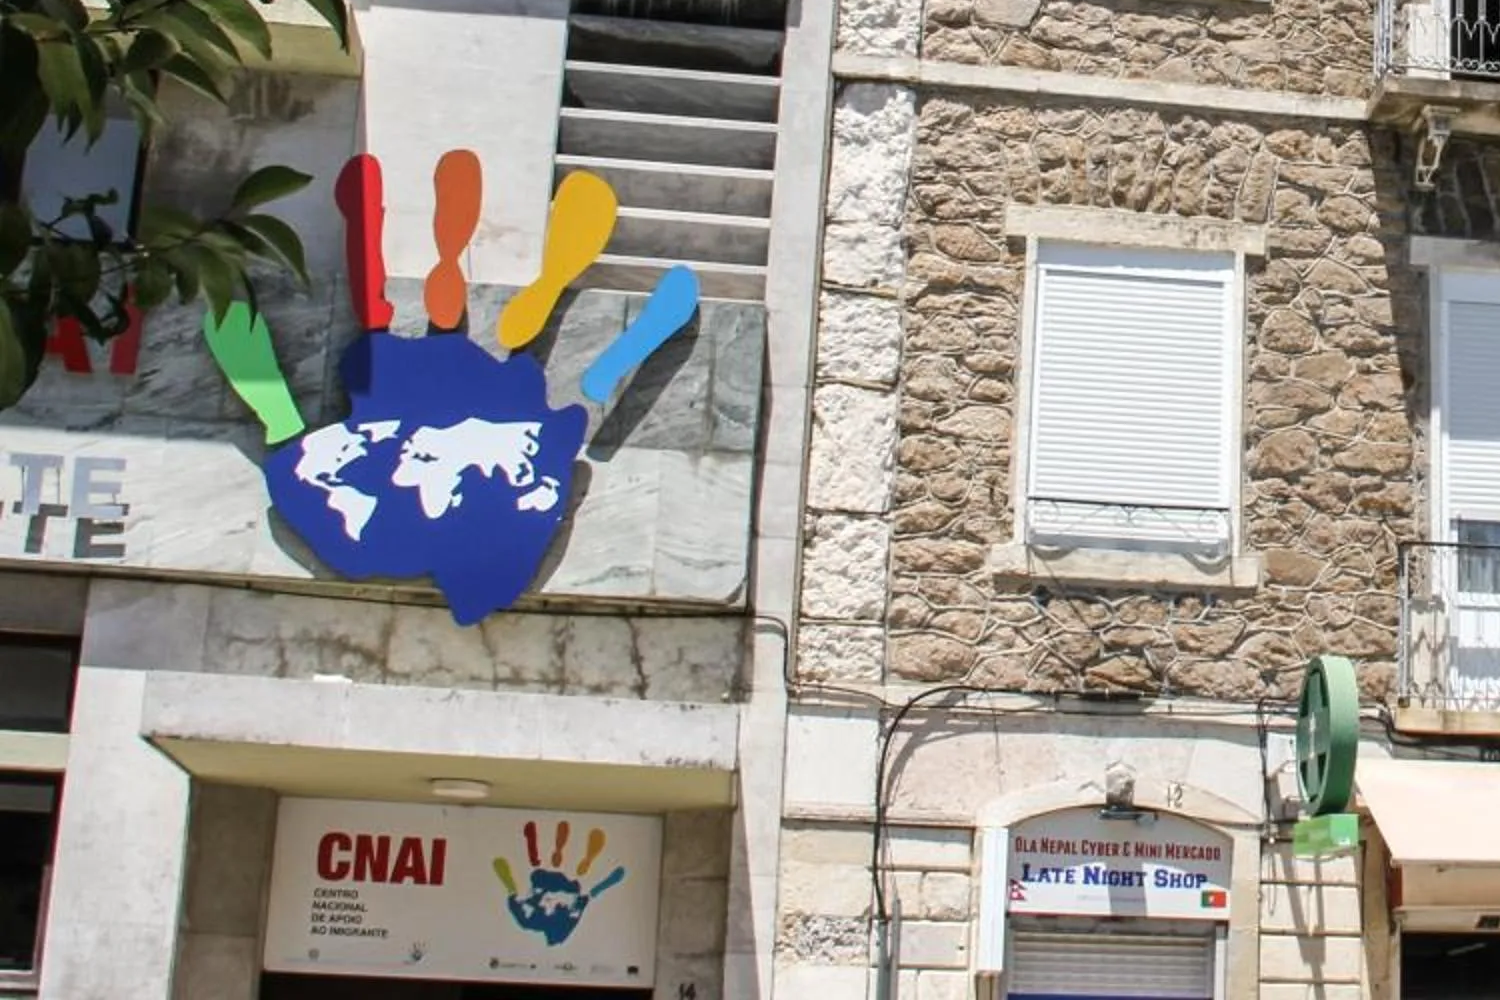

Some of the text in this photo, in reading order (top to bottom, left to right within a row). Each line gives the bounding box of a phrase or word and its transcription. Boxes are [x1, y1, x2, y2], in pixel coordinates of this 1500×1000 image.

[1166, 782, 1183, 809] 12
[1040, 837, 1078, 856] NEPAL
[1081, 839, 1120, 858] CYBER
[1134, 842, 1162, 858] MINI
[1165, 843, 1221, 861] MERCADO
[316, 832, 447, 886] CNAI
[1022, 863, 1209, 889] LATE NIGHT SHOP
[313, 887, 359, 900] CENTRO
[312, 900, 368, 912] NACIONAL
[311, 913, 363, 925] DE APOIO
[310, 926, 389, 938] AO IMIGRANTE
